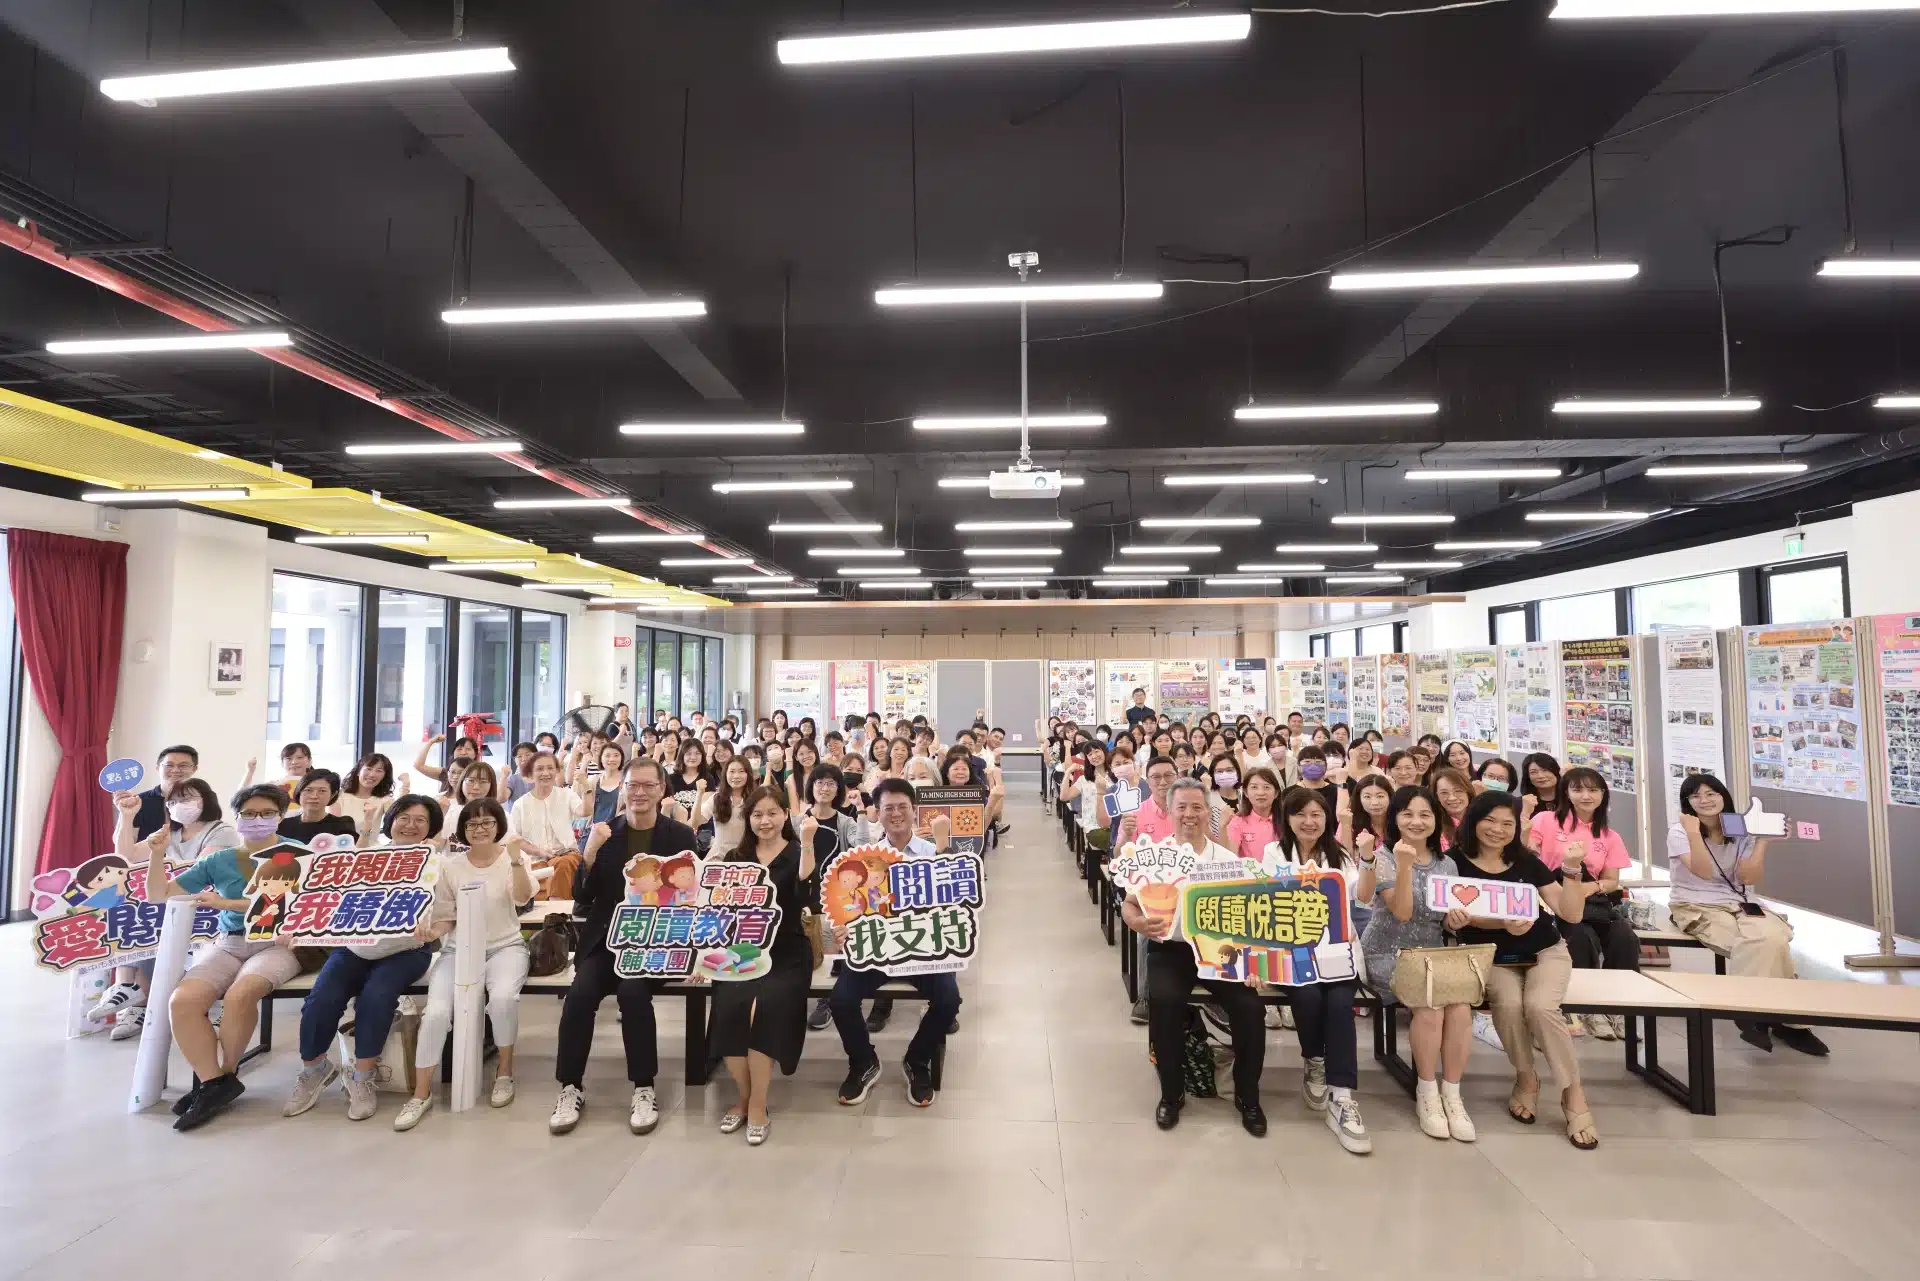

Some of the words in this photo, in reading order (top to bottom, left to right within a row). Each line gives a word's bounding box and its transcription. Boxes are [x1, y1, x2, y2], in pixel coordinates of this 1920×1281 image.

[921, 791, 943, 799] TA-MING
[1804, 827, 1814, 835] 19
[308, 850, 425, 887] 我閱讀
[703, 868, 760, 885] 臺中市
[1118, 847, 1196, 878] 大明高中
[712, 887, 768, 905] 教育局
[890, 859, 978, 908] 閱讀
[1432, 879, 1449, 908] I
[1482, 884, 1532, 917] TM
[281, 890, 427, 932] 我驕傲
[611, 908, 774, 945] 閱讀教育
[1195, 890, 1329, 945] 閱讀悅讚
[849, 910, 968, 961] 我支持
[620, 950, 690, 971] 輔導團
